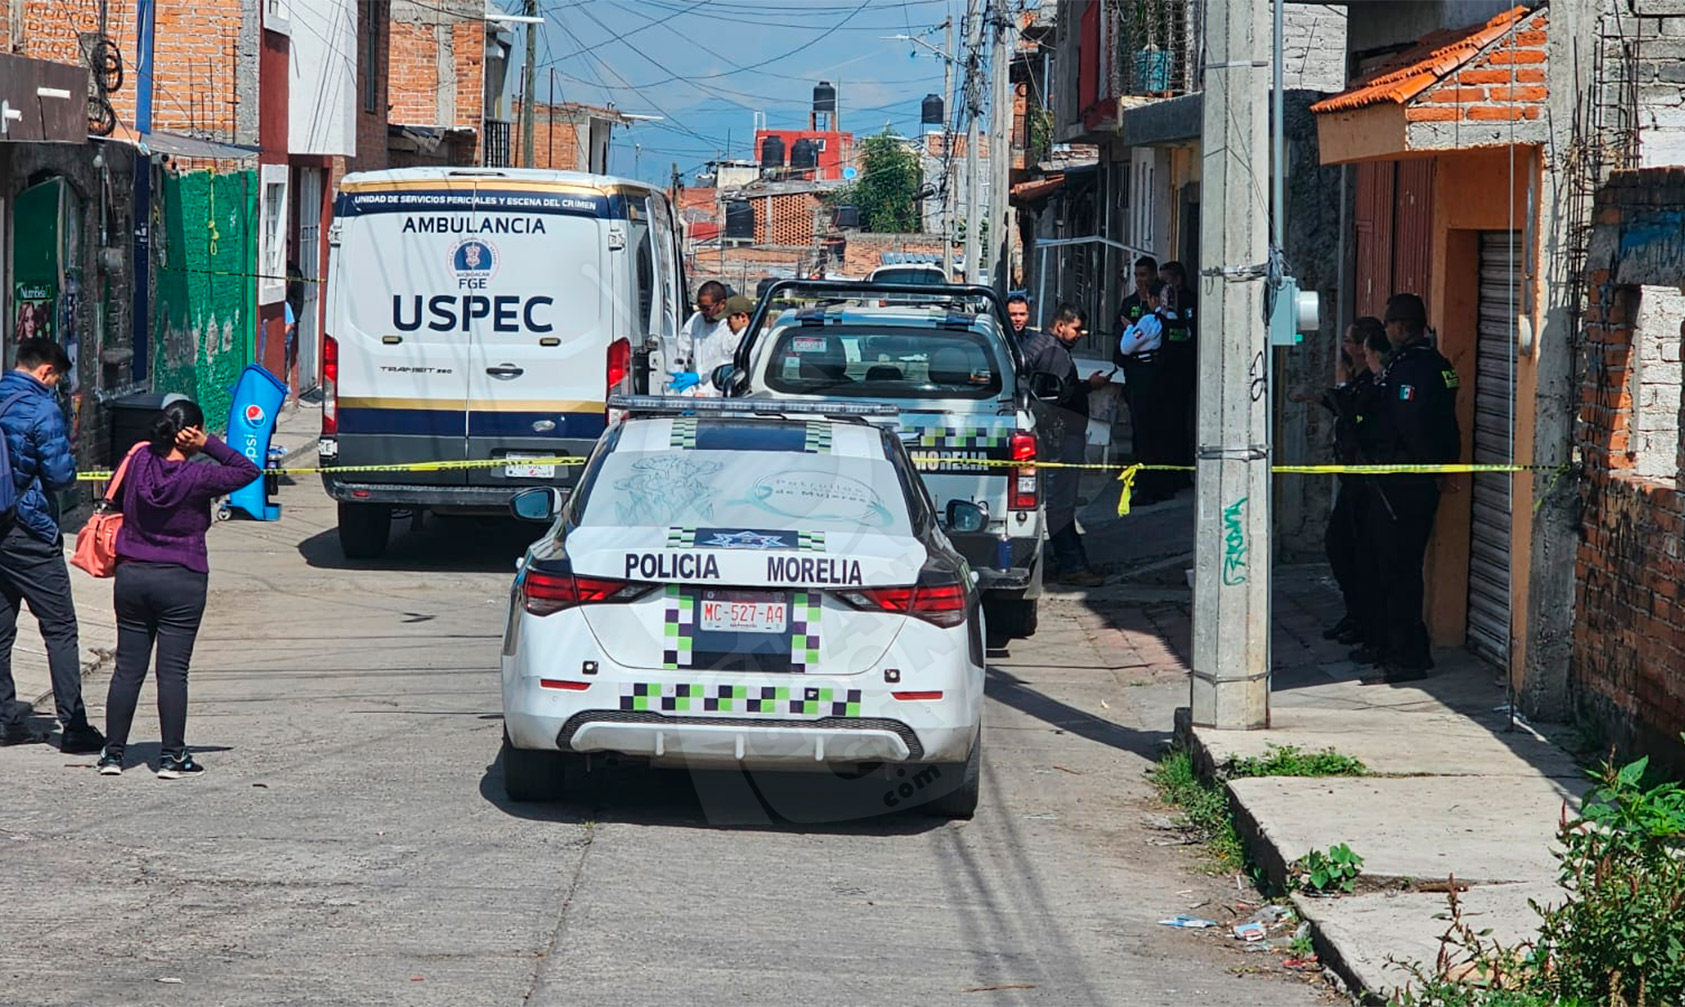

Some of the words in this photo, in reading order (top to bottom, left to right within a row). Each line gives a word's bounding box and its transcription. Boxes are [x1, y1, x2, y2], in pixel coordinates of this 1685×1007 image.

[354, 195, 386, 204] UNIDAD
[387, 195, 400, 204] DE
[400, 195, 446, 204] SERVICIOS
[447, 196, 497, 205] PERICIALES
[499, 196, 507, 205] Y
[507, 197, 542, 207] ESCENA
[543, 198, 561, 208] DEL
[562, 199, 597, 211] CRIMEN
[402, 216, 547, 234] AMBULANCIA
[458, 278, 488, 290] FGE
[392, 294, 555, 333] USPEC
[910, 450, 990, 471] MORELIA
[624, 552, 720, 579] POLICIA
[766, 555, 863, 586] MORELIA
[704, 603, 783, 623] MC-527-A4
